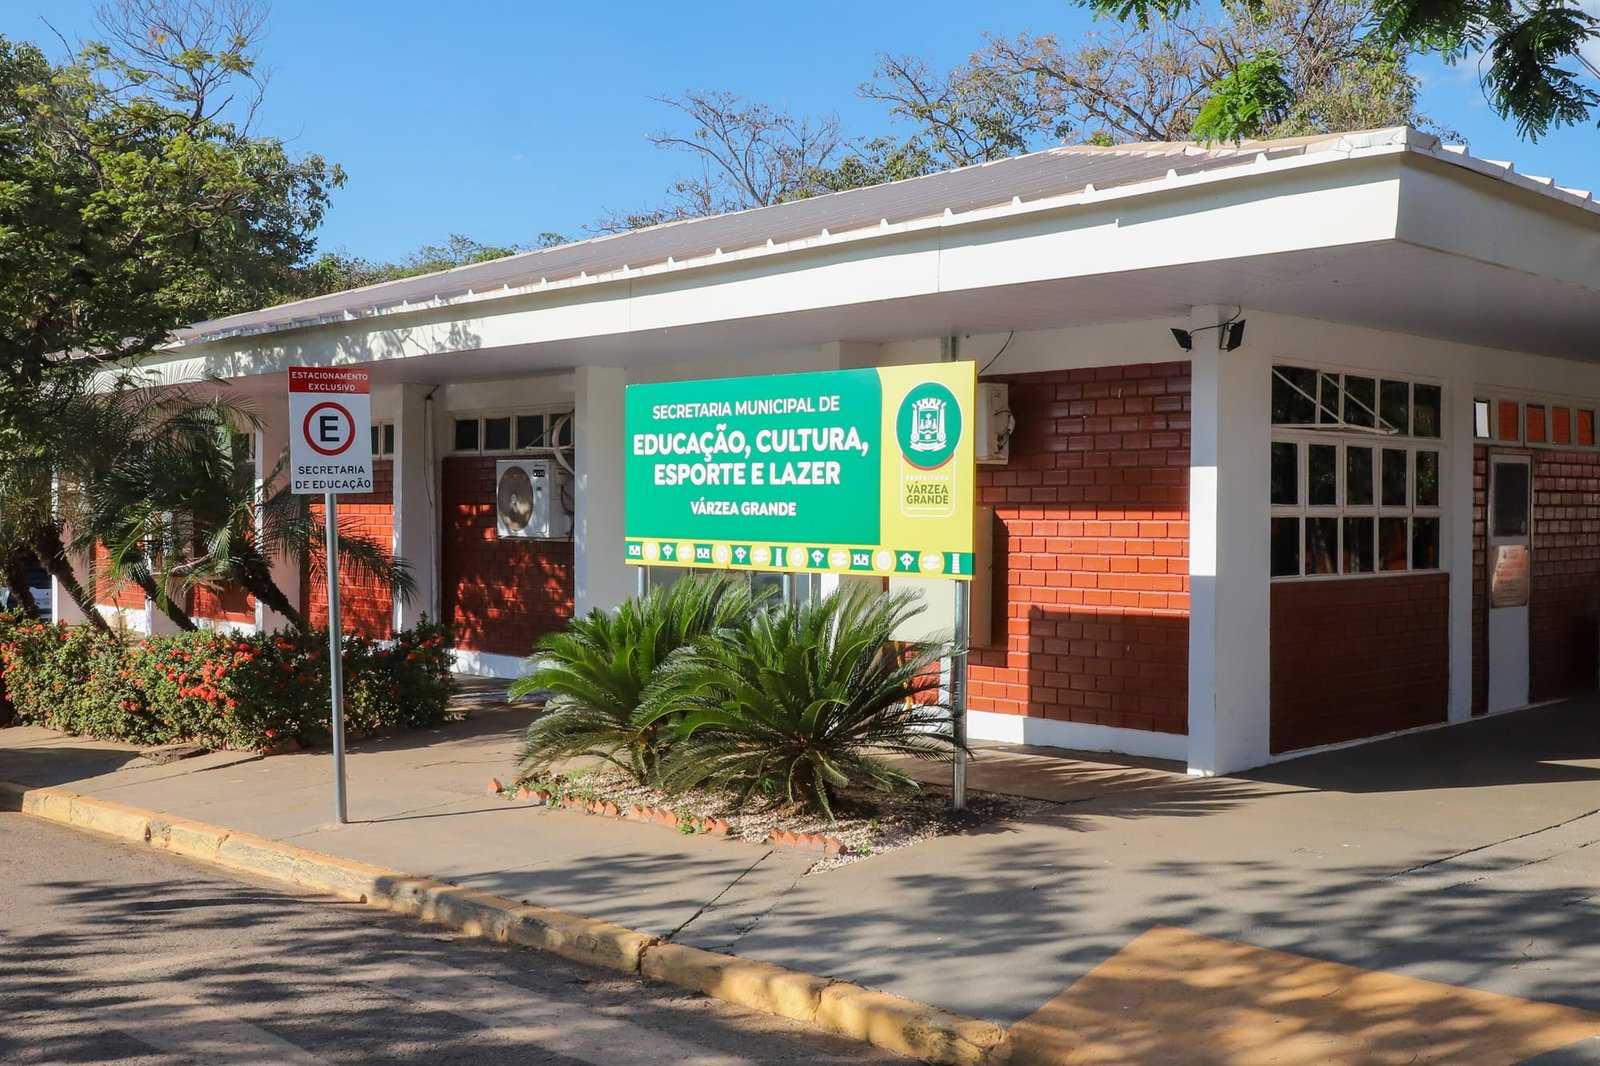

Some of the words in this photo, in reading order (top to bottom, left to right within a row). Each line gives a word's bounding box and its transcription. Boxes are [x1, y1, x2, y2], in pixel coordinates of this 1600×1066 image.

[291, 371, 368, 380] ESTACIONAMENTO
[308, 383, 356, 391] EXCLUSIVO
[652, 401, 733, 420] SECRETARIA
[735, 397, 816, 416] MUNICIPAL
[819, 395, 841, 412] DE
[319, 415, 340, 442] E
[633, 422, 751, 463] EDUCAÇÃO,
[755, 426, 869, 457] CULTURA,
[298, 465, 366, 475] SECRETARIA
[654, 462, 746, 486] ESPORTE
[751, 462, 765, 485] E
[769, 461, 841, 485] LAZER
[295, 480, 310, 489] DE
[312, 477, 371, 490] EDUCAÇÃO
[906, 481, 949, 494] VÁRZEA
[689, 496, 739, 516] VÁRZEA
[740, 501, 797, 517] GRANDE
[906, 495, 949, 505] GRANDE
